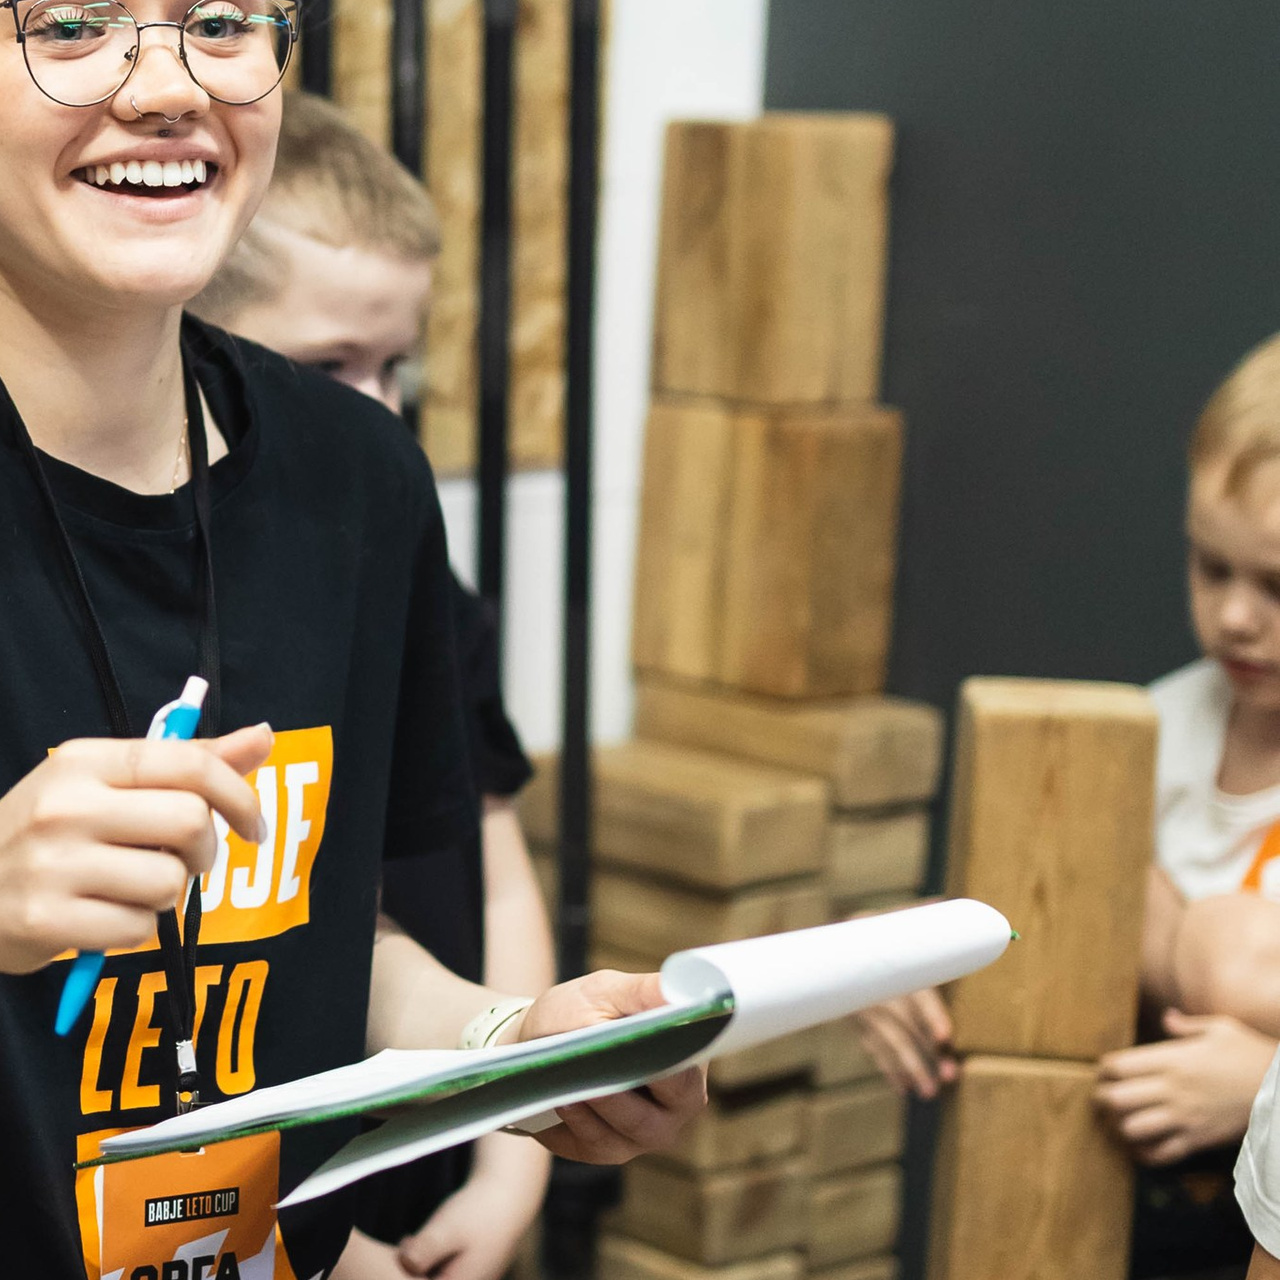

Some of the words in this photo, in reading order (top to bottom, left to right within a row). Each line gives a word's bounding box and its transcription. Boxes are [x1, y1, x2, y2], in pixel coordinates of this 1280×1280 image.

[148, 1199, 183, 1223] BABJE
[186, 1195, 212, 1218] LETO
[214, 1191, 236, 1213] CUP
